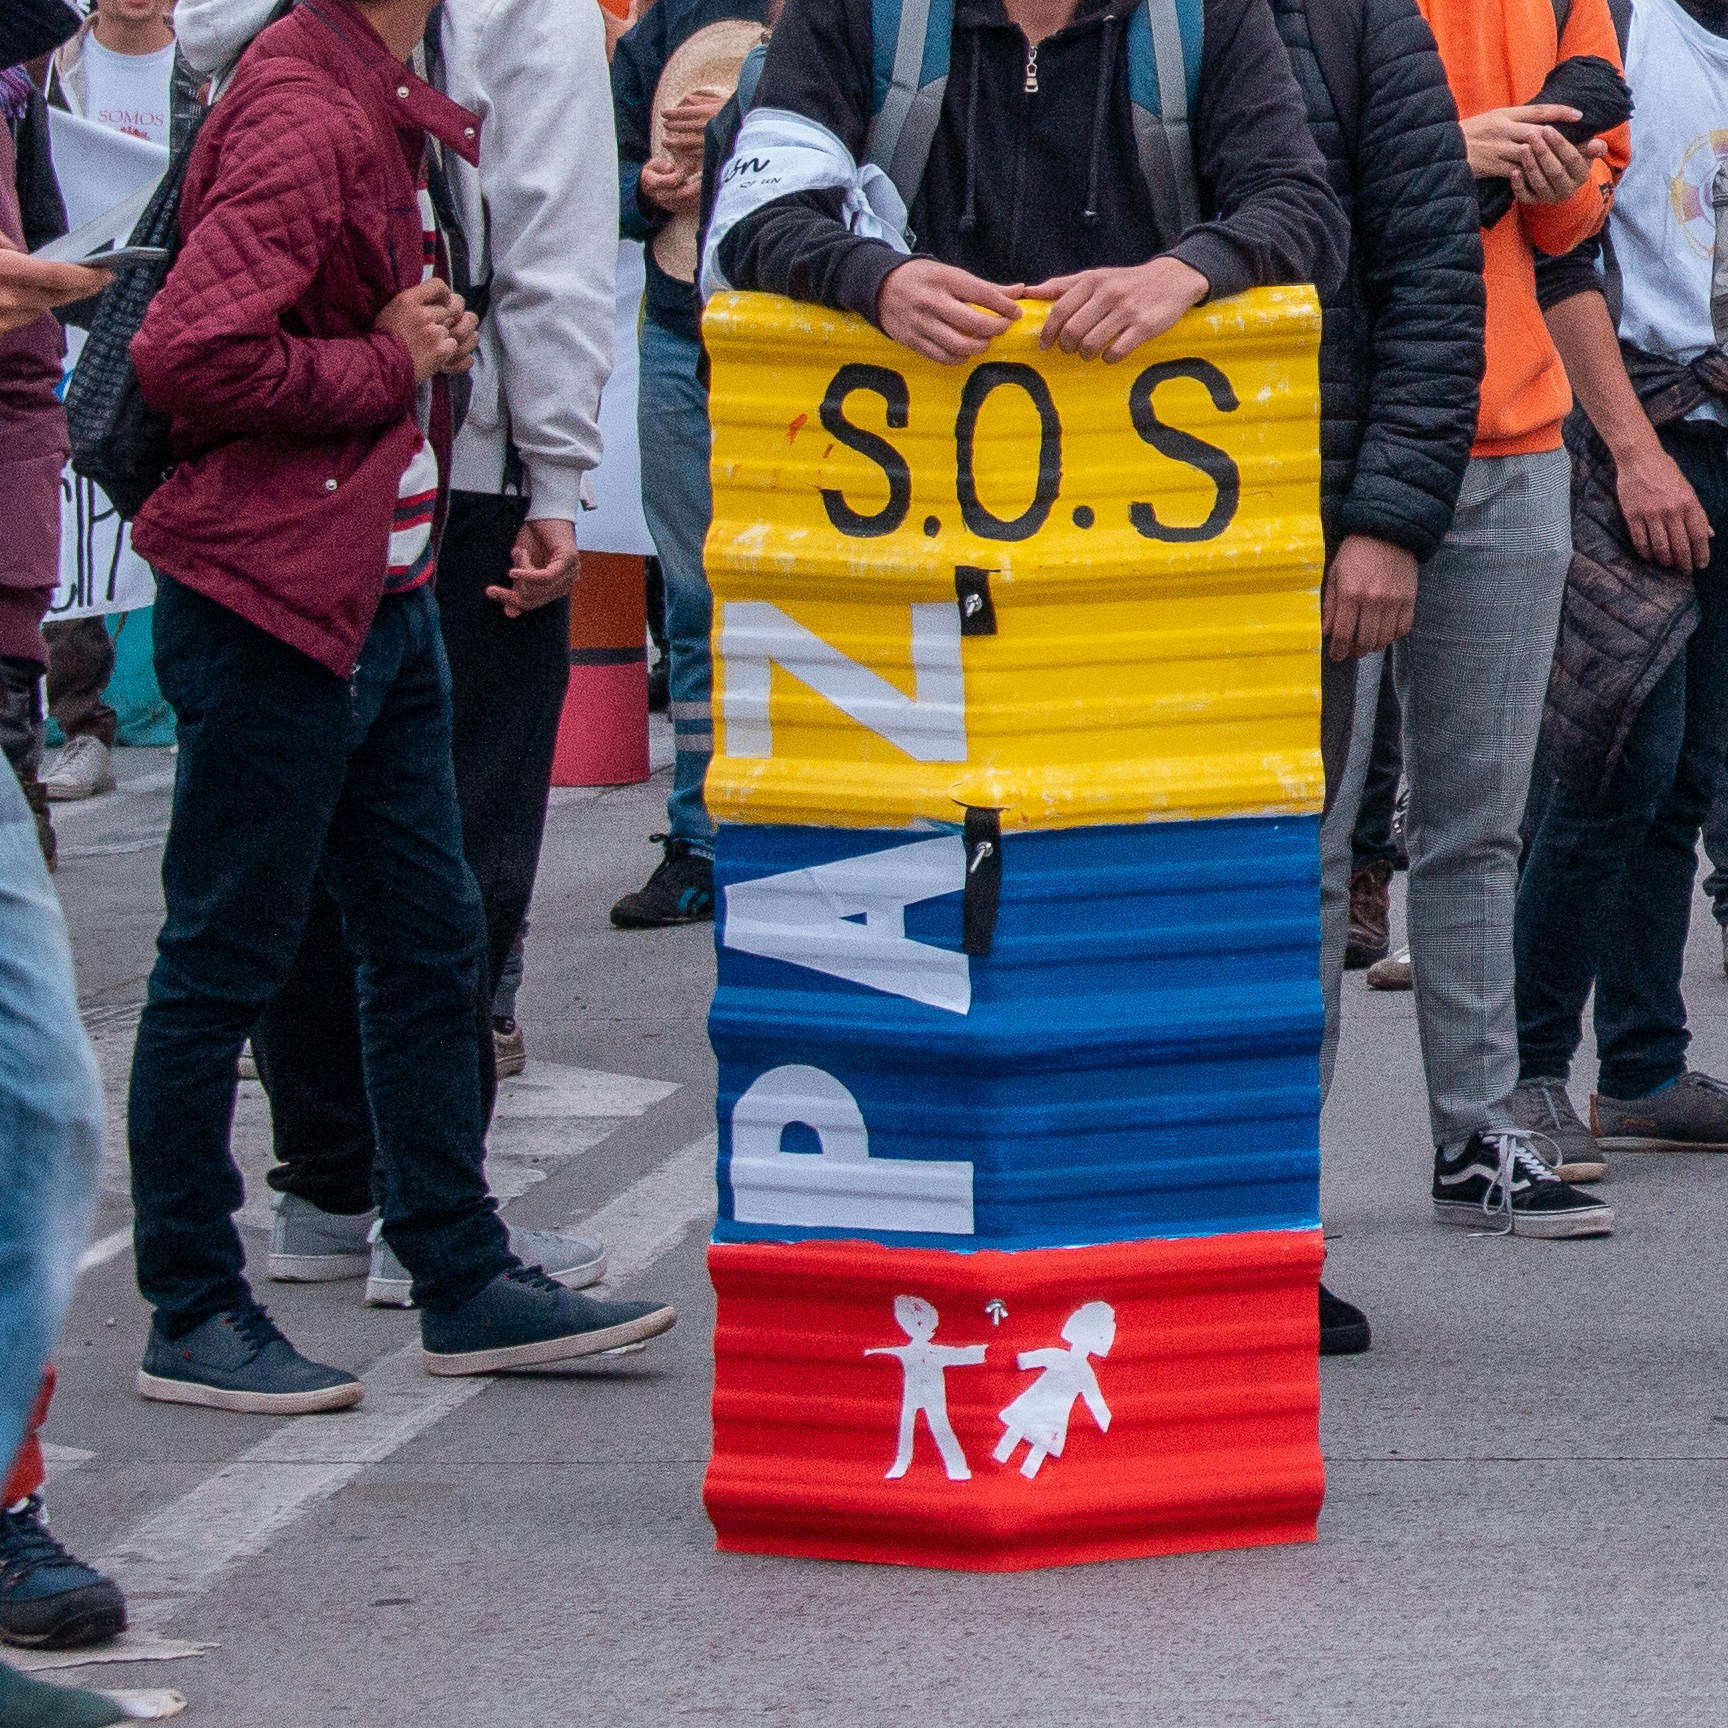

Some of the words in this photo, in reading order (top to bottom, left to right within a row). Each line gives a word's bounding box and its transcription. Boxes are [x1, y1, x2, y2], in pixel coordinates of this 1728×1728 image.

[99, 110, 164, 126] SOMOS
[819, 357, 1241, 543] S.O.S
[719, 601, 975, 1235] PAZ
